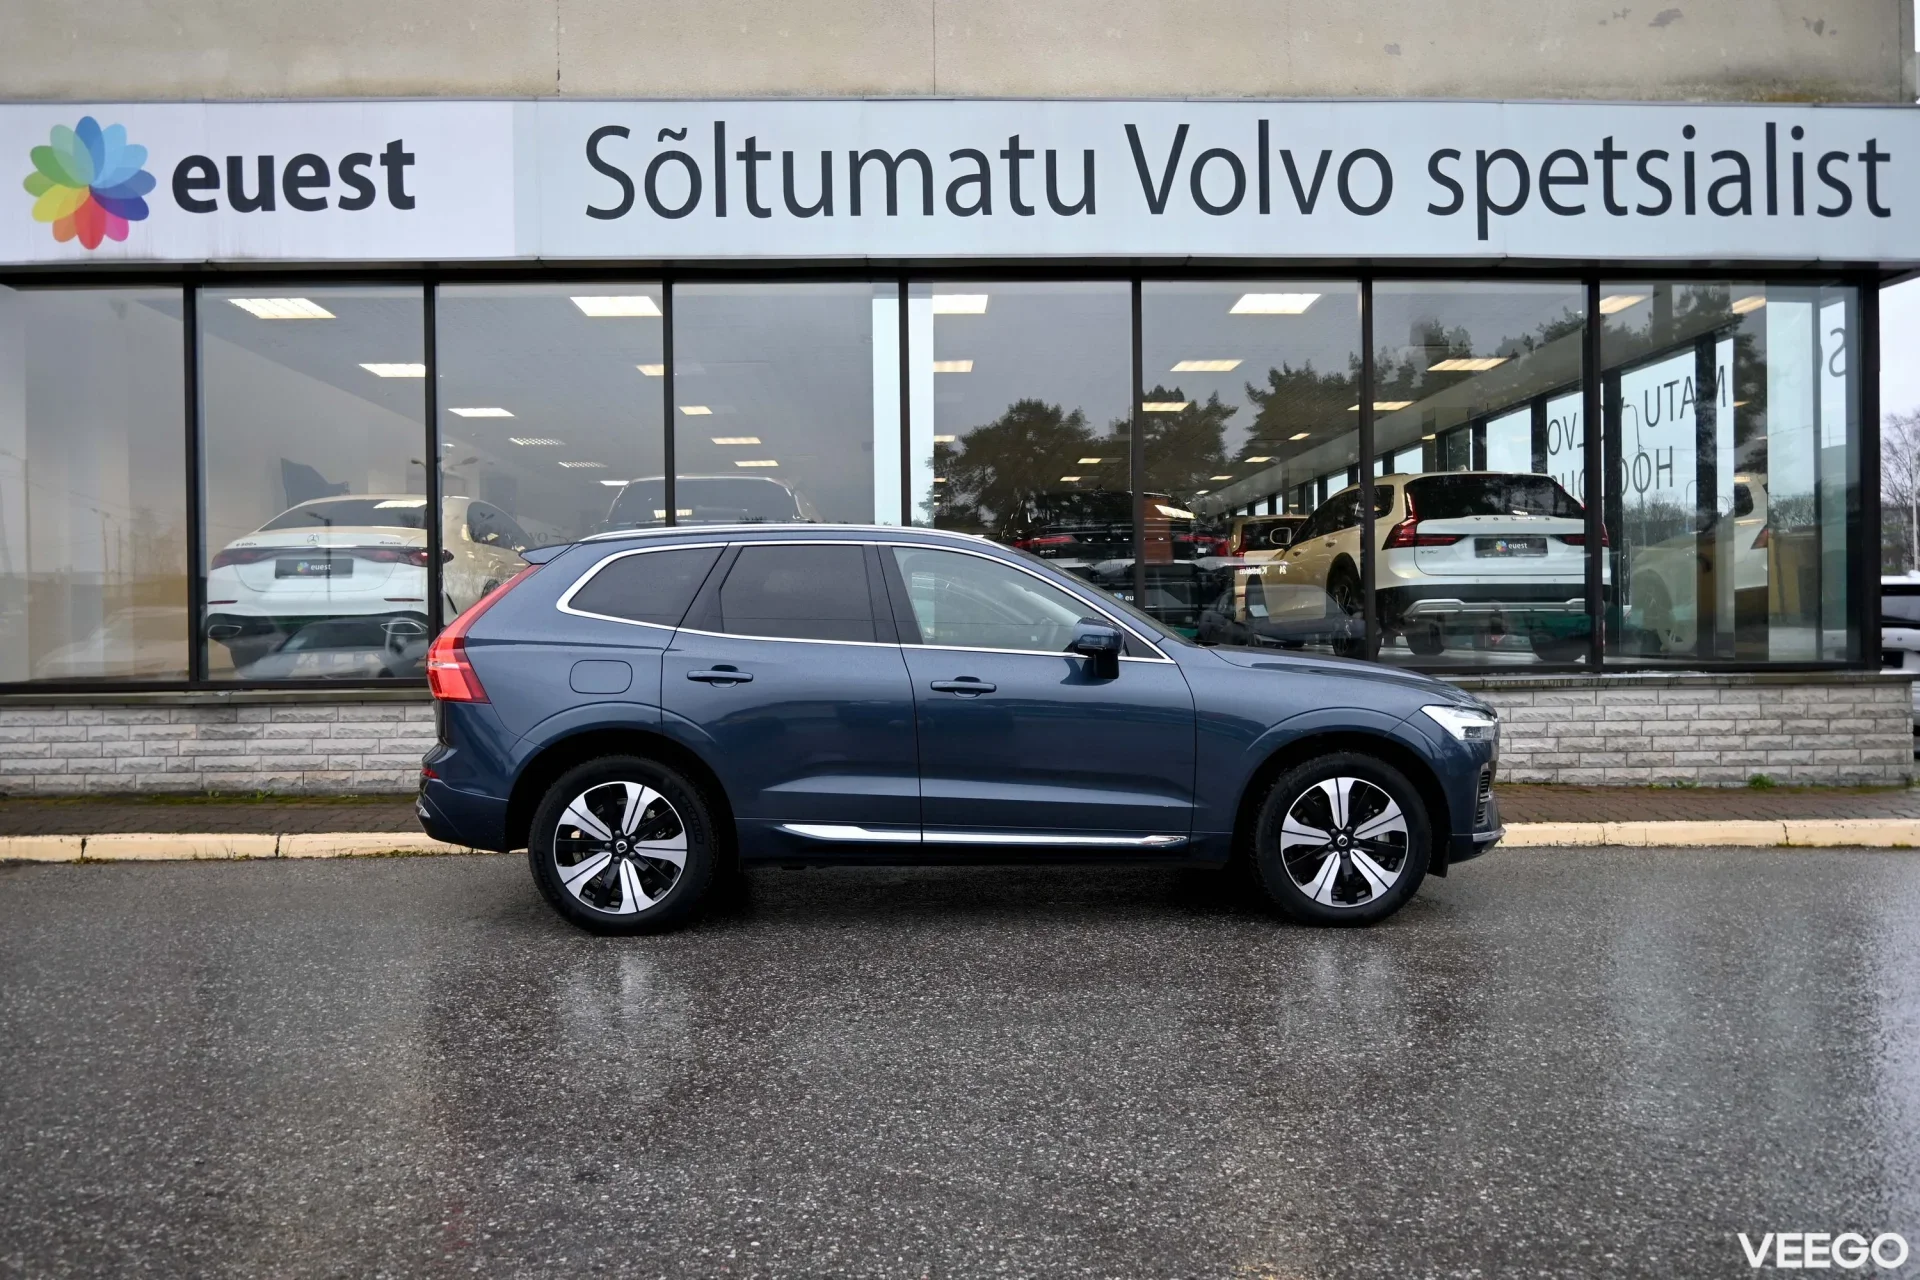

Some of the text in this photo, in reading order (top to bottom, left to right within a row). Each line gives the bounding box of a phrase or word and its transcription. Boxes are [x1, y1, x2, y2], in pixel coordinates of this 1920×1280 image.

[171, 138, 416, 214] euest
[585, 118, 1892, 242] Sõltumatu Volvo spetsialist
[310, 562, 332, 571] euest
[1508, 542, 1528, 550] euest
